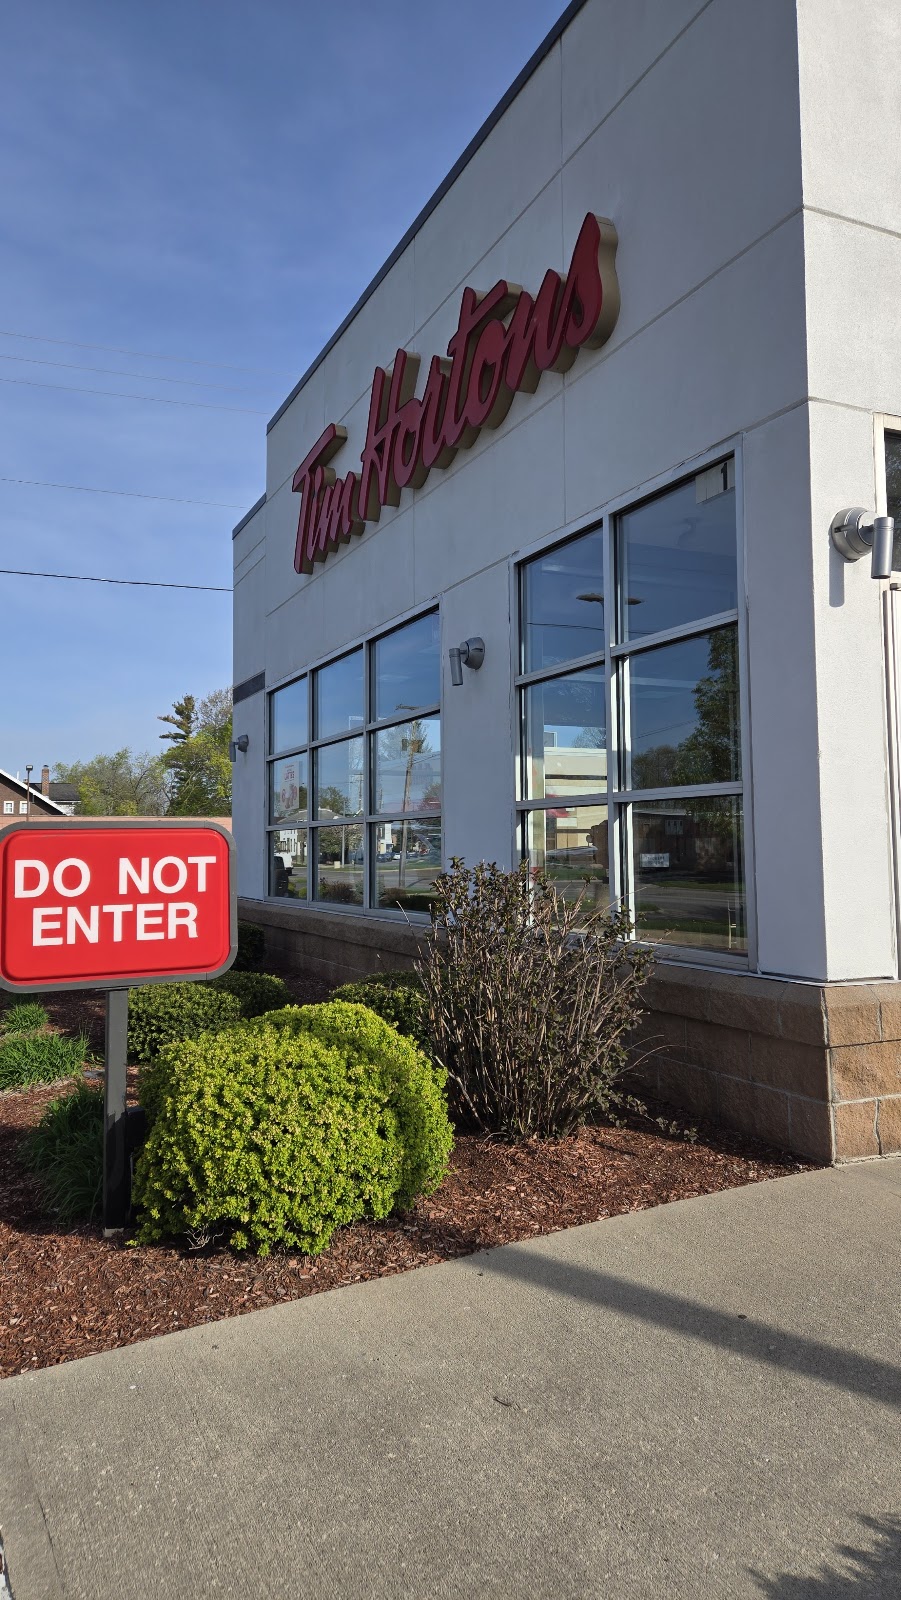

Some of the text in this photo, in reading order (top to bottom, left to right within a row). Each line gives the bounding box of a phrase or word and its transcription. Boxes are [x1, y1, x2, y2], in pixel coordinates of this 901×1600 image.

[292, 212, 606, 574] Tim Hortons
[720, 462, 728, 491] 1
[14, 856, 217, 898] DO NOT
[32, 902, 198, 947] ENTER
